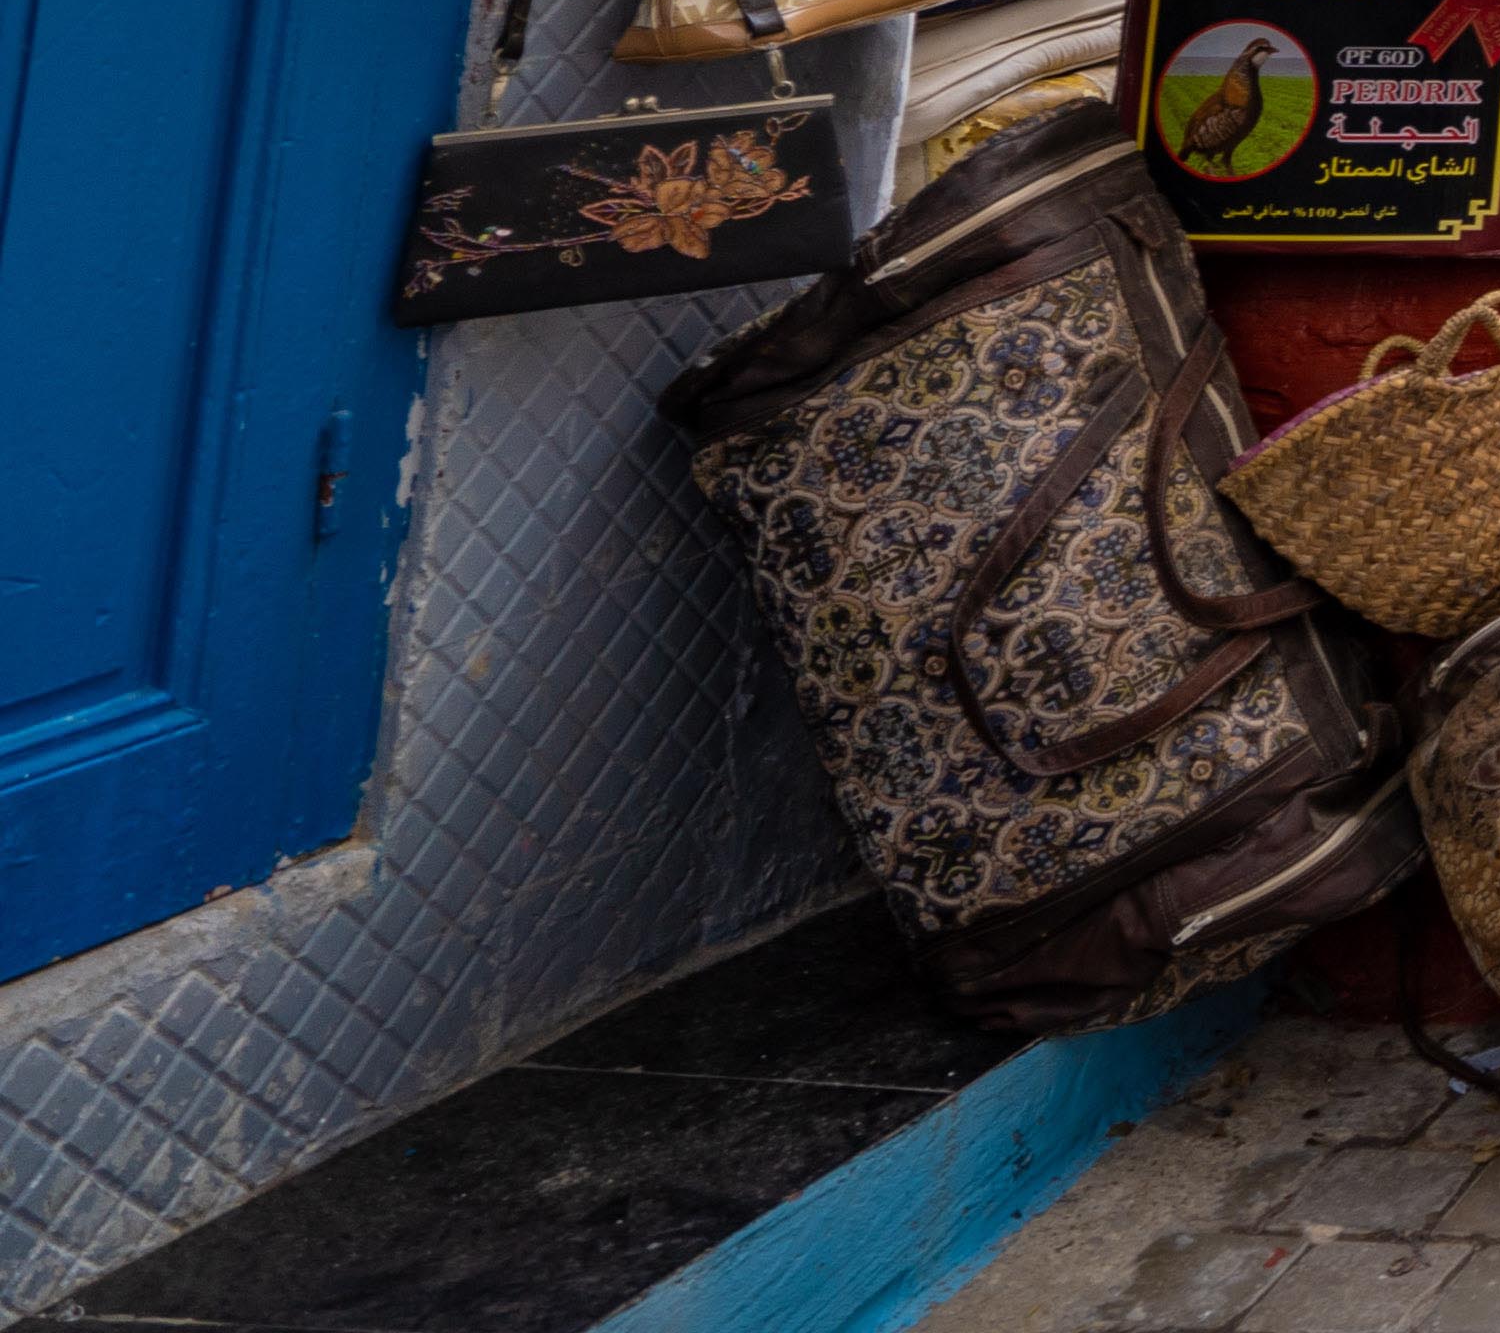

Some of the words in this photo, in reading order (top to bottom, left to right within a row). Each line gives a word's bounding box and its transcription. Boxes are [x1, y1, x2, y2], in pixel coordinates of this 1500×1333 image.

[1345, 48, 1372, 65] PF
[1376, 48, 1416, 66] 601
[1330, 79, 1483, 105] PERDRIX
[1315, 156, 1404, 185] الممتاز
[1406, 156, 1477, 185] الشاي
